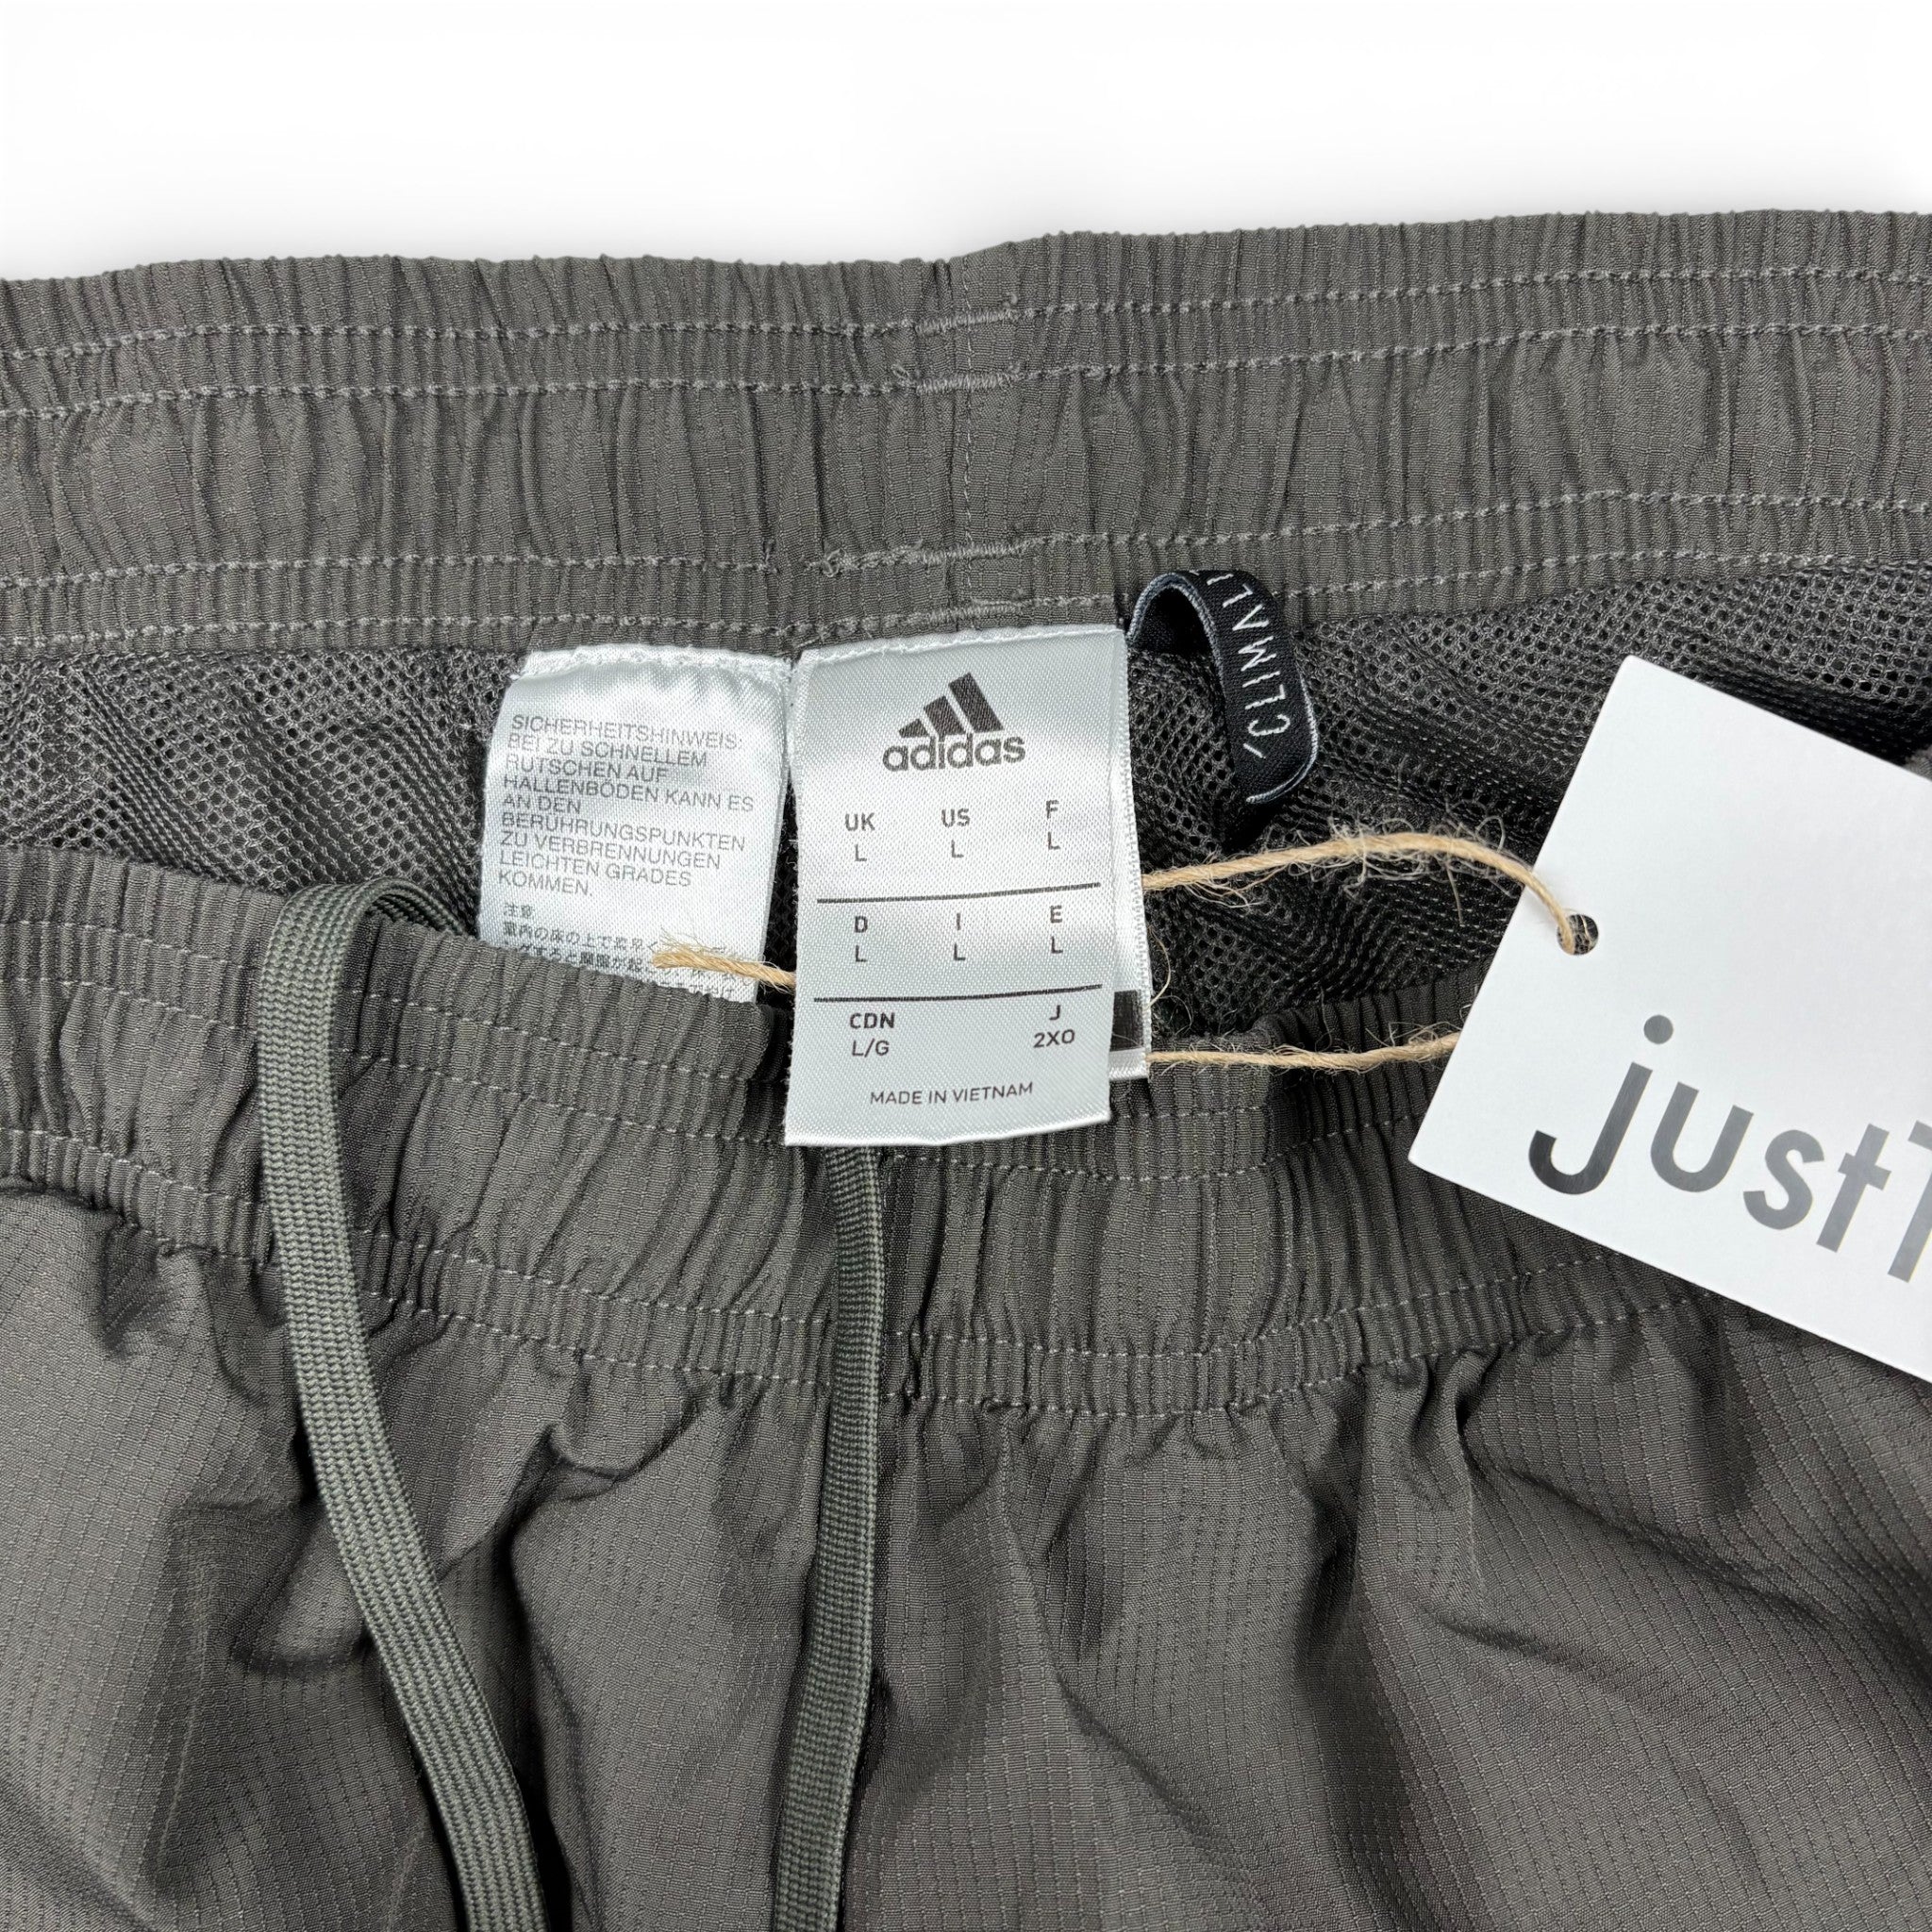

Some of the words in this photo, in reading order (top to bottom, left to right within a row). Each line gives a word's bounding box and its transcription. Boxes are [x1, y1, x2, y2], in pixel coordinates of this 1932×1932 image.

[508, 734, 540, 753] BEI
[546, 739, 575, 756] ZU
[581, 741, 708, 767] SCHNELLEM
[882, 733, 1026, 772] adidas
[506, 754, 621, 779] RUTSCHEN
[627, 767, 669, 783] AUF
[504, 774, 659, 803] HALLENBÖDEN
[666, 789, 722, 809] KANN
[728, 796, 754, 812] ES
[504, 794, 530, 810] AN
[538, 796, 581, 815] DEN
[1045, 799, 1059, 820] F
[844, 812, 875, 832] UK
[941, 808, 971, 828] US
[501, 811, 745, 852] BERÜHRUNGSPUNKTEN
[1047, 831, 1061, 850] L
[500, 829, 527, 848] ZU
[534, 834, 721, 870] VERBRENNUNGEN
[854, 843, 867, 862] L
[951, 840, 964, 858] L
[499, 851, 599, 877] LEICHTEN
[605, 863, 692, 887] GRADES
[498, 871, 593, 897] KOMMEN.
[854, 915, 869, 934] D
[956, 912, 962, 931] I
[1050, 905, 1064, 924] E
[855, 944, 868, 963] L
[953, 943, 966, 961] L
[1050, 937, 1064, 955] L
[849, 1011, 895, 1029] CDN
[1048, 1005, 1062, 1021] J
[851, 1039, 891, 1057] L/G
[1033, 1028, 1075, 1048] 2XO
[870, 1090, 923, 1106] MADE
[928, 1088, 946, 1104] IN
[953, 1081, 1034, 1103] VIETNAM
